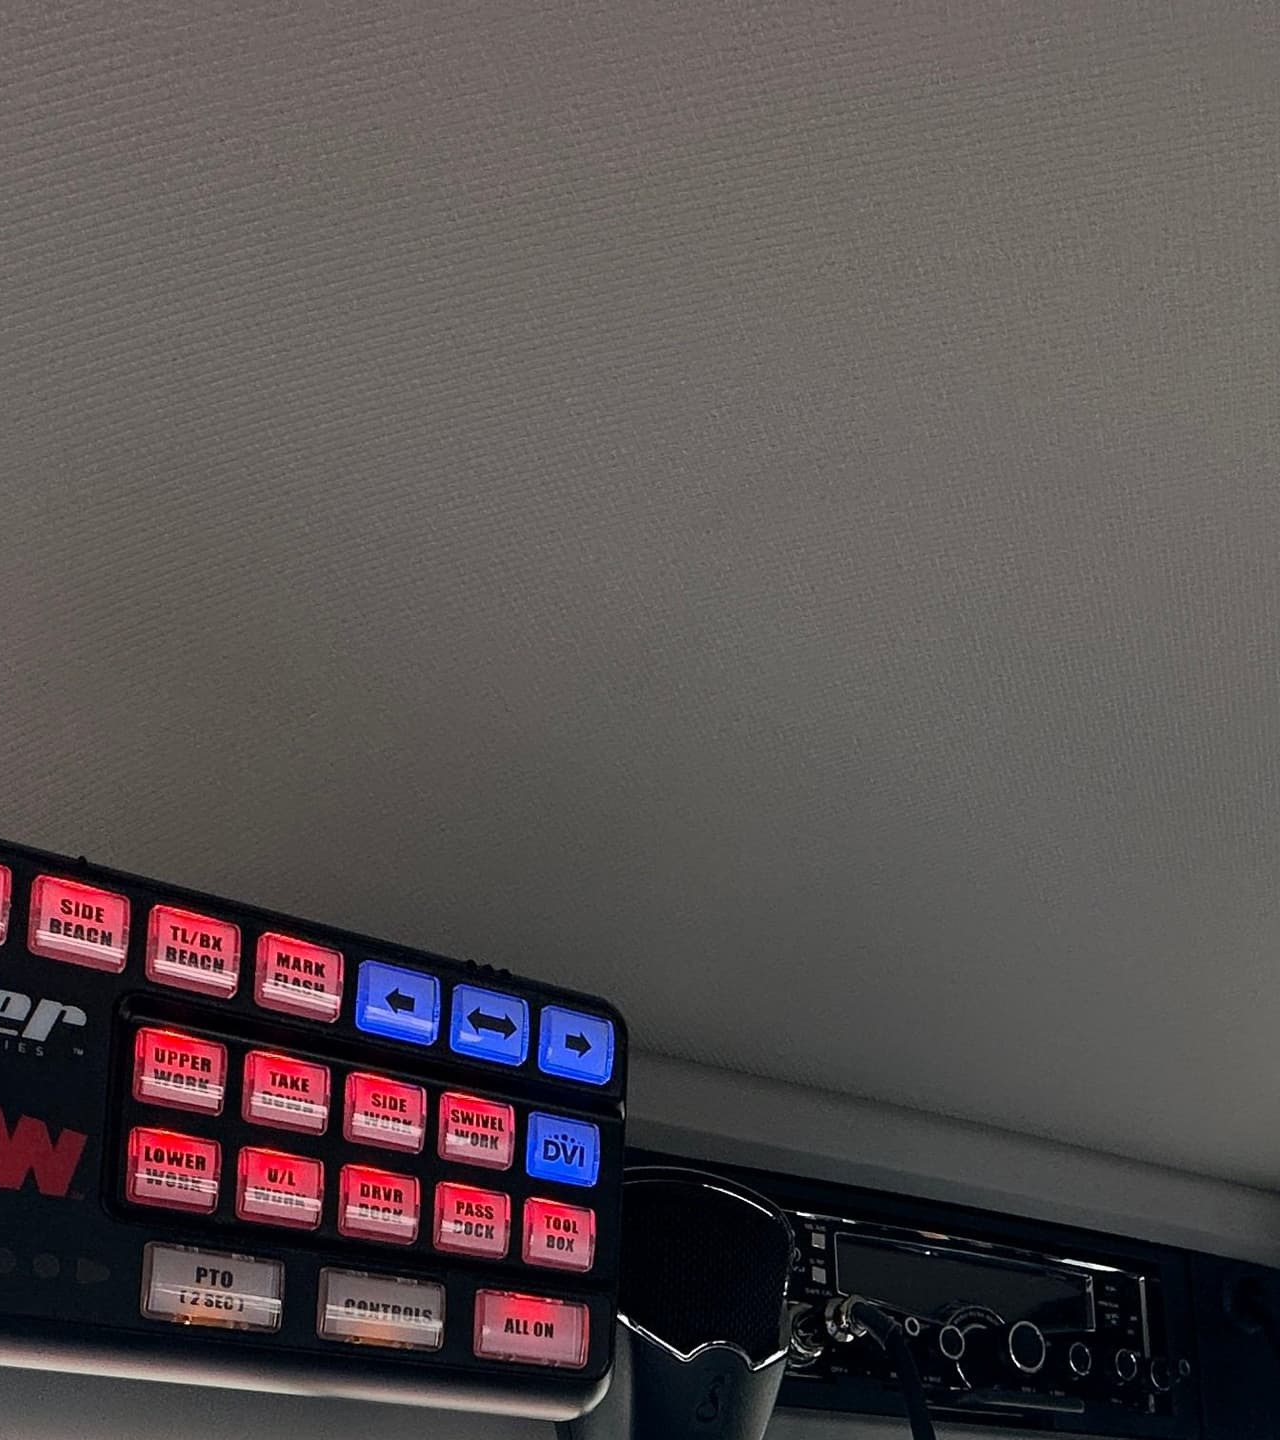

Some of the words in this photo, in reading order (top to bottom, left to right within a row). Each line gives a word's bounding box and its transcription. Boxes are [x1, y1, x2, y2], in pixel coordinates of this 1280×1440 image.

[60, 898, 105, 923] SIDE
[49, 918, 113, 947] BEACN
[170, 926, 223, 952] TL/BX
[165, 946, 224, 974] BEACN
[276, 952, 326, 978] MARK
[273, 973, 325, 997] FLASH
[154, 1047, 212, 1073] UPPER
[153, 1069, 209, 1093] WORK
[270, 1071, 310, 1093] TAKE
[371, 1093, 408, 1113] SIDE
[363, 1111, 413, 1134] WORK
[450, 1108, 505, 1132] SWIVEL
[454, 1129, 500, 1150] WORK
[144, 1146, 206, 1171] LOWER
[542, 1138, 586, 1168] DVI
[145, 1168, 203, 1193] WORK
[267, 1168, 296, 1187] U/L
[360, 1183, 404, 1203] DRVR
[456, 1200, 494, 1220] PASS
[453, 1219, 495, 1240] DOCK
[544, 1215, 579, 1235] TOOL
[546, 1235, 575, 1253] BOX
[195, 1265, 234, 1289] PTO
[343, 1298, 434, 1325] CONTROLS
[504, 1319, 528, 1337] ALL
[532, 1322, 555, 1340] ON
